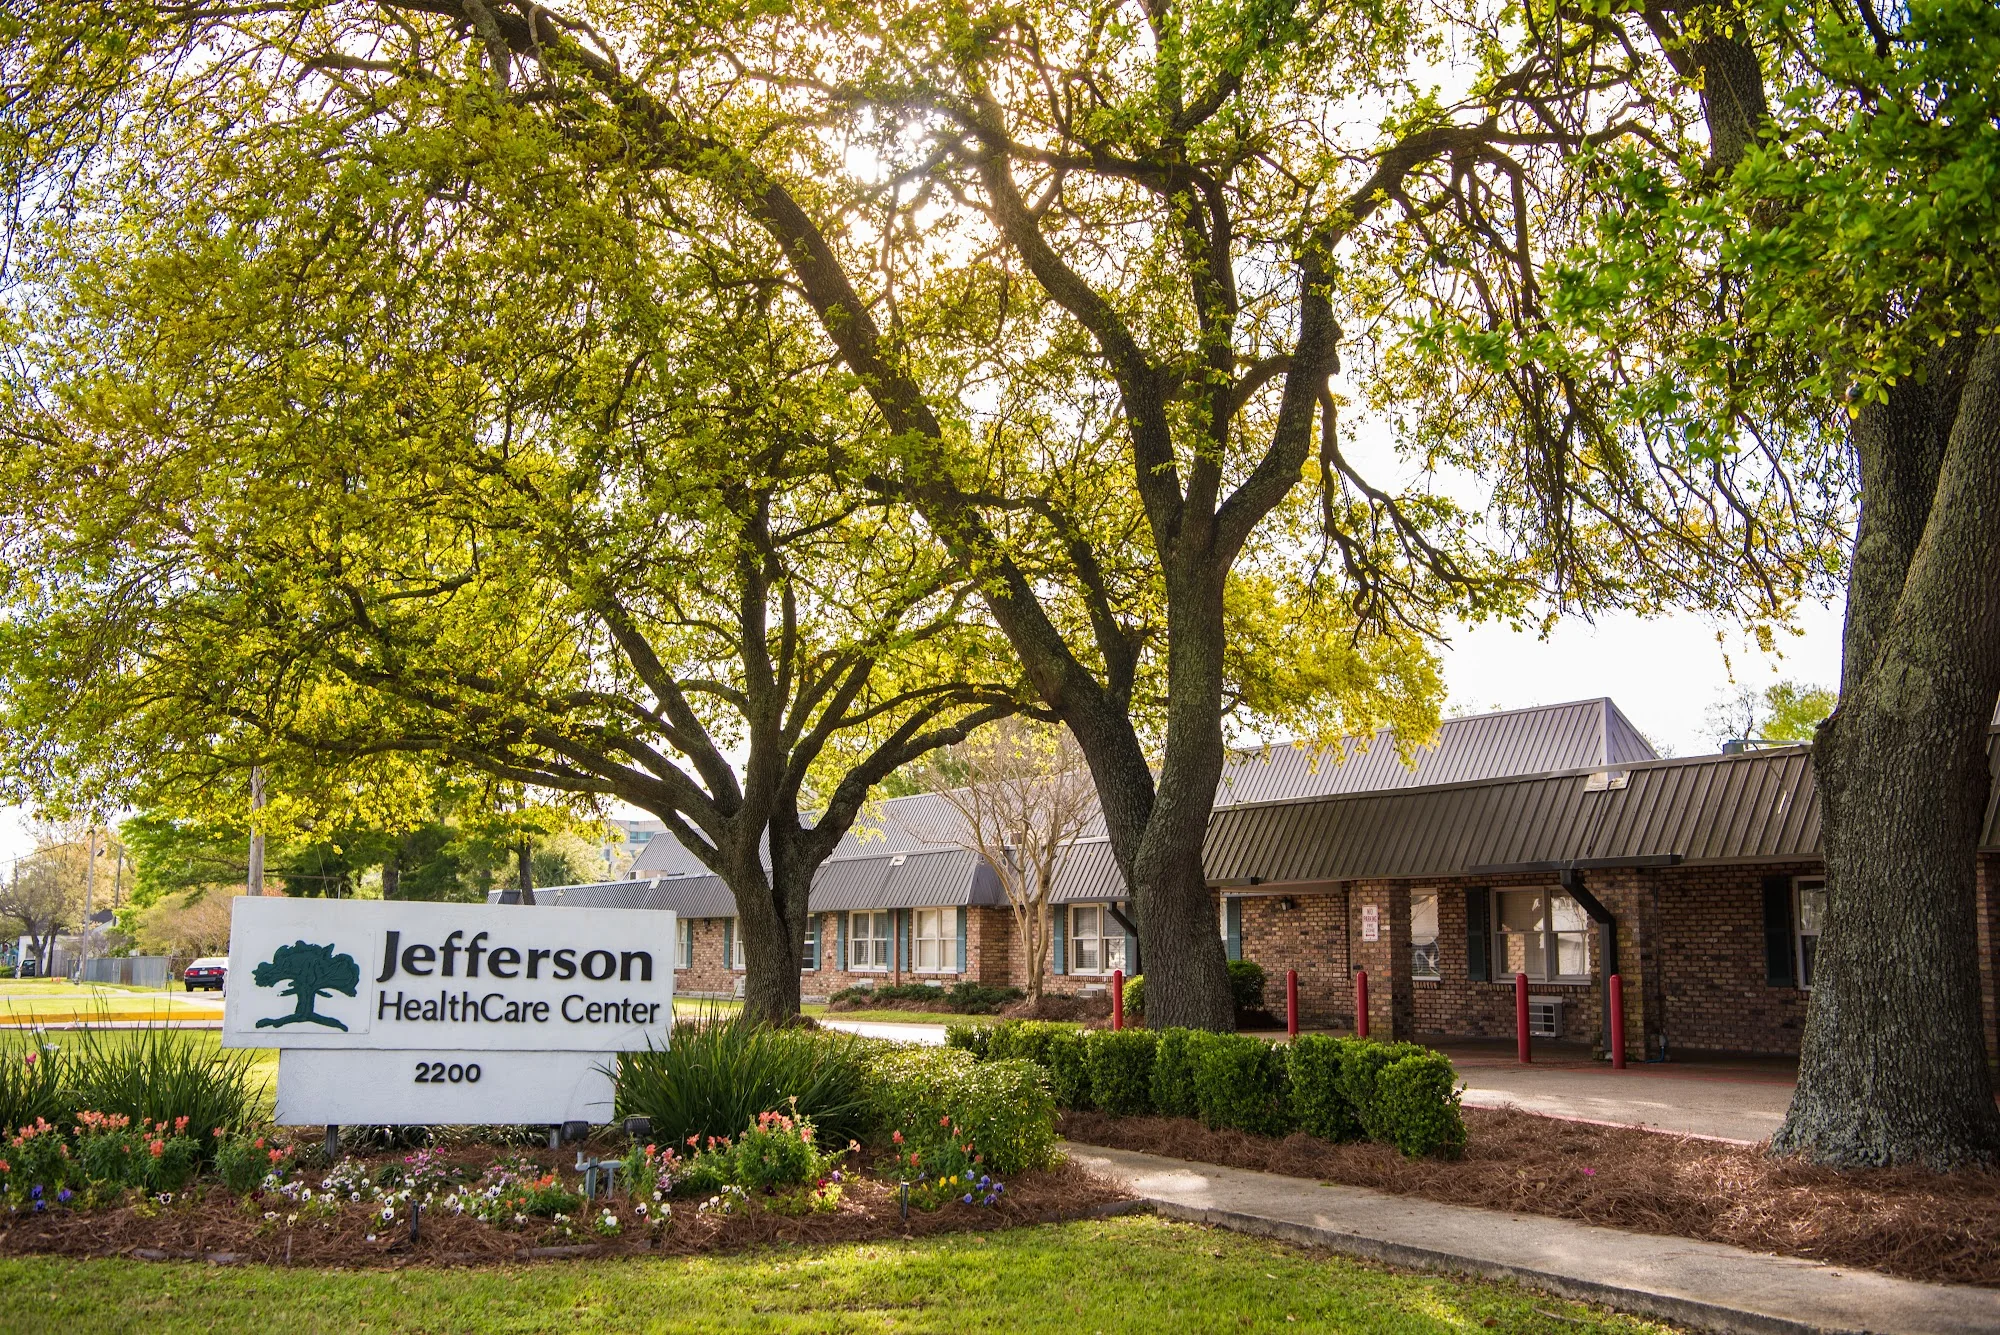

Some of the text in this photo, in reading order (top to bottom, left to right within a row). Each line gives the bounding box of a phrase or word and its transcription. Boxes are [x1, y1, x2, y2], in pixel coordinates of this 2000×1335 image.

[376, 930, 653, 983] Jefferson
[377, 990, 661, 1025] HealthCare Center
[414, 1062, 482, 1084] 2200
